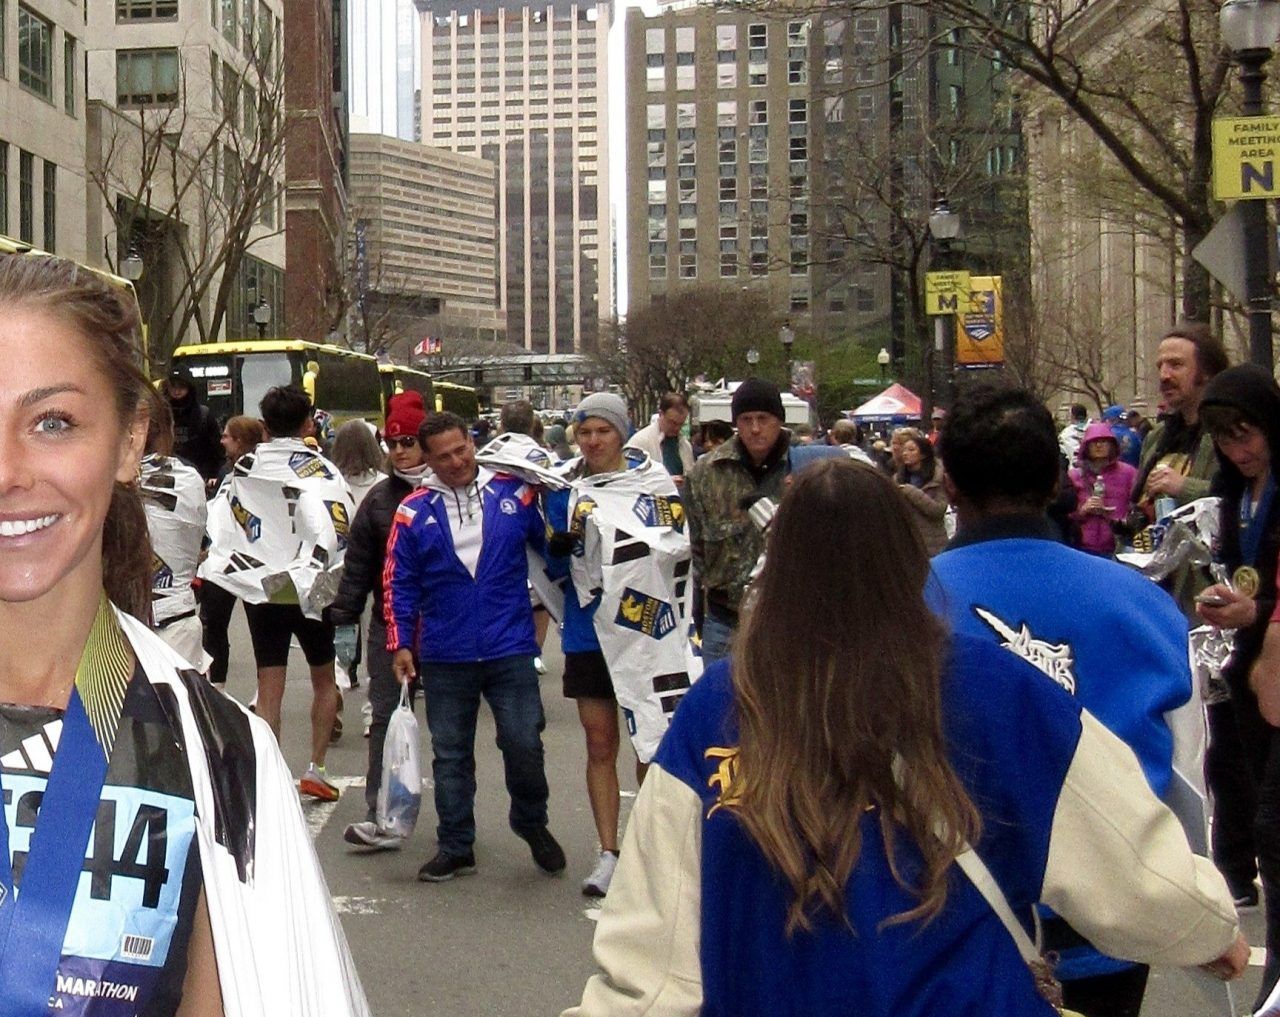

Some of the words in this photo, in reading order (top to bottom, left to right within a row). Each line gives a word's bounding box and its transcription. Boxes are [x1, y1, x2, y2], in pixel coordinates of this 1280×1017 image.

[1233, 123, 1280, 132] FAMILY
[1240, 148, 1275, 158] AREA
[1241, 161, 1273, 193] N
[938, 294, 958, 311] M
[56, 973, 139, 1002] MARATHON
